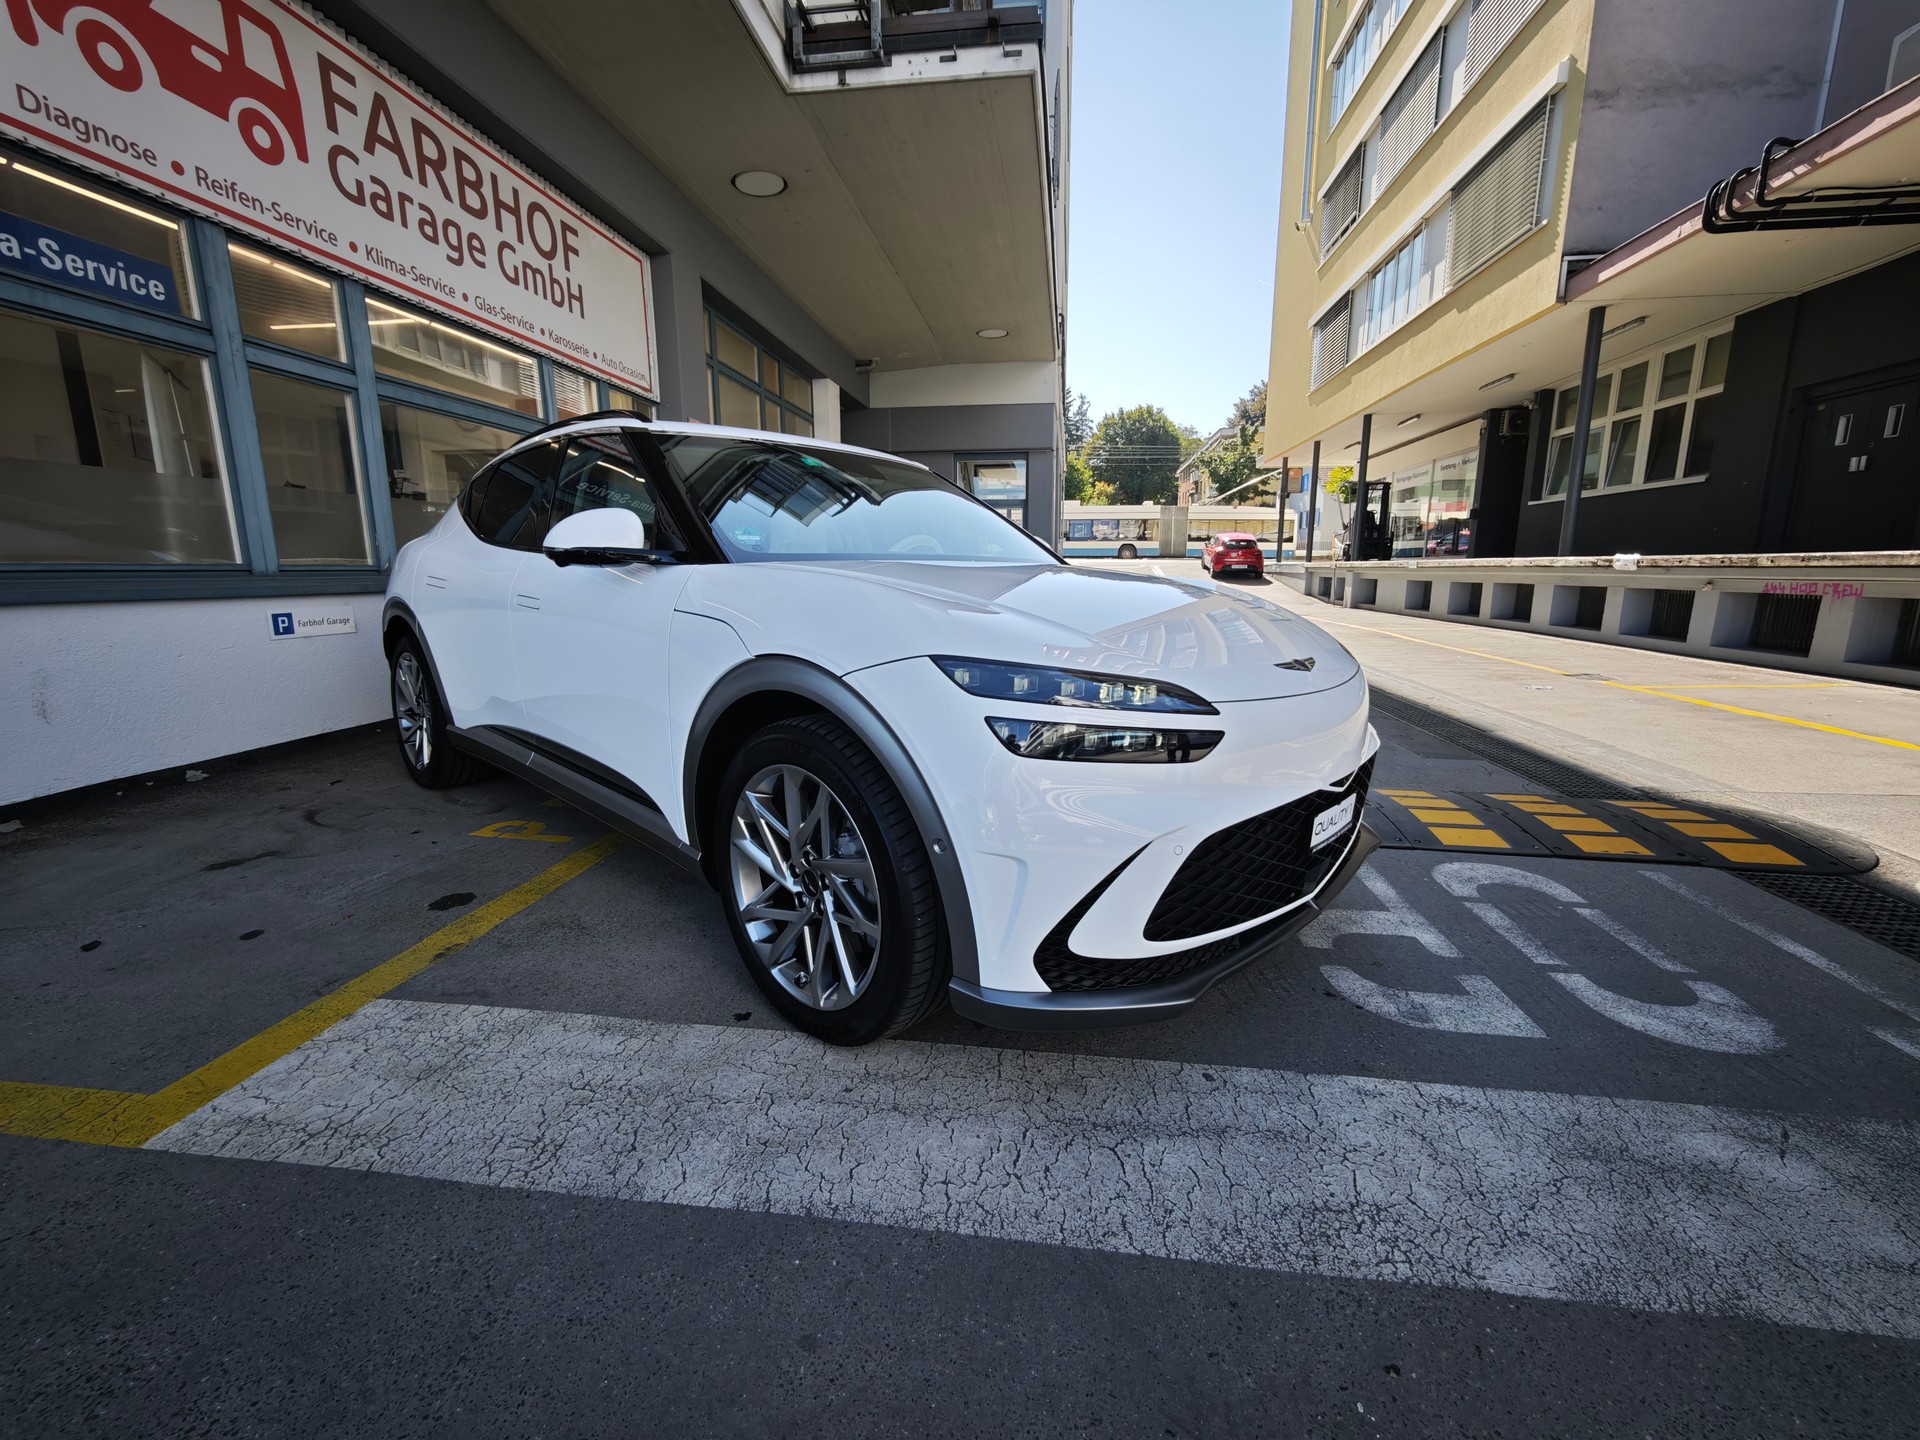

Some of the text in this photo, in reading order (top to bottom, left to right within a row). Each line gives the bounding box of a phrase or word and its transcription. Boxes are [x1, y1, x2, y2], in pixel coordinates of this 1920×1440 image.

[317, 51, 580, 272] FARBHOF
[0, 232, 166, 301] a-Service
[15, 83, 646, 381] Diagnose Reifen-Service Klima-Service Glas-Service Karosserie Auto Occasion
[327, 144, 586, 319] Garage GmbH
[277, 616, 289, 633] P
[298, 617, 350, 628] Farbhof Garage
